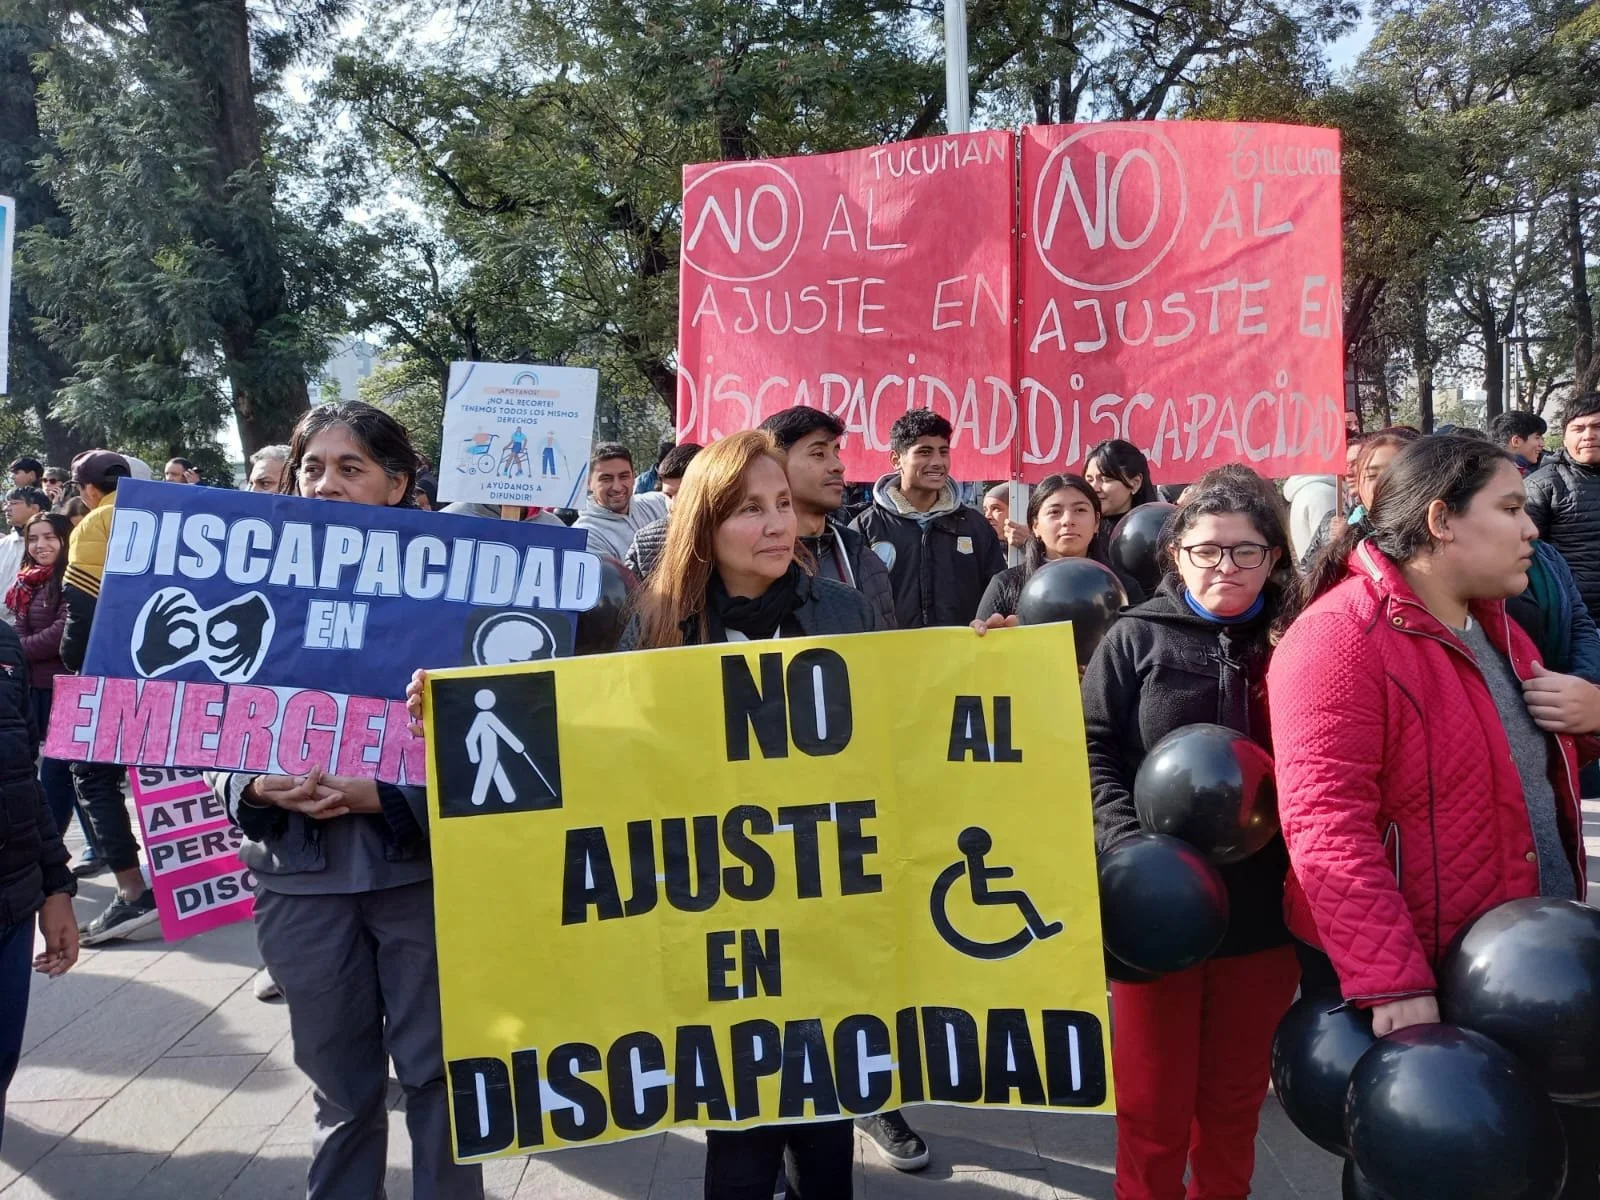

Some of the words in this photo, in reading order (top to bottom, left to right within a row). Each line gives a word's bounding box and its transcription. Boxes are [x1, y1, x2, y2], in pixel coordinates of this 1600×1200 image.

[870, 138, 1005, 180] TUCUMAN
[685, 184, 788, 254] NO
[822, 187, 908, 252] AL
[1042, 148, 1161, 250] NO
[1200, 181, 1294, 252] AL
[691, 277, 886, 335] AJUSTE
[932, 264, 1008, 331] EN
[1029, 277, 1270, 353] AJUSTE
[461, 404, 497, 414] TENEMOS
[500, 407, 528, 416] TODOS
[530, 409, 545, 417] LOS
[547, 410, 579, 419] MISMOS
[497, 416, 538, 425] DERECHOS
[516, 399, 554, 408] RECORTE!
[489, 491, 532, 501] DIFUNDIR!
[105, 508, 603, 612] DISCAPACIDAD
[303, 601, 369, 651] EN
[721, 648, 853, 762] NO
[947, 695, 1023, 763] AL
[562, 799, 882, 926] AJUSTE
[706, 928, 782, 1002] EN
[449, 1006, 1107, 1160] DISCAPACIDAD
